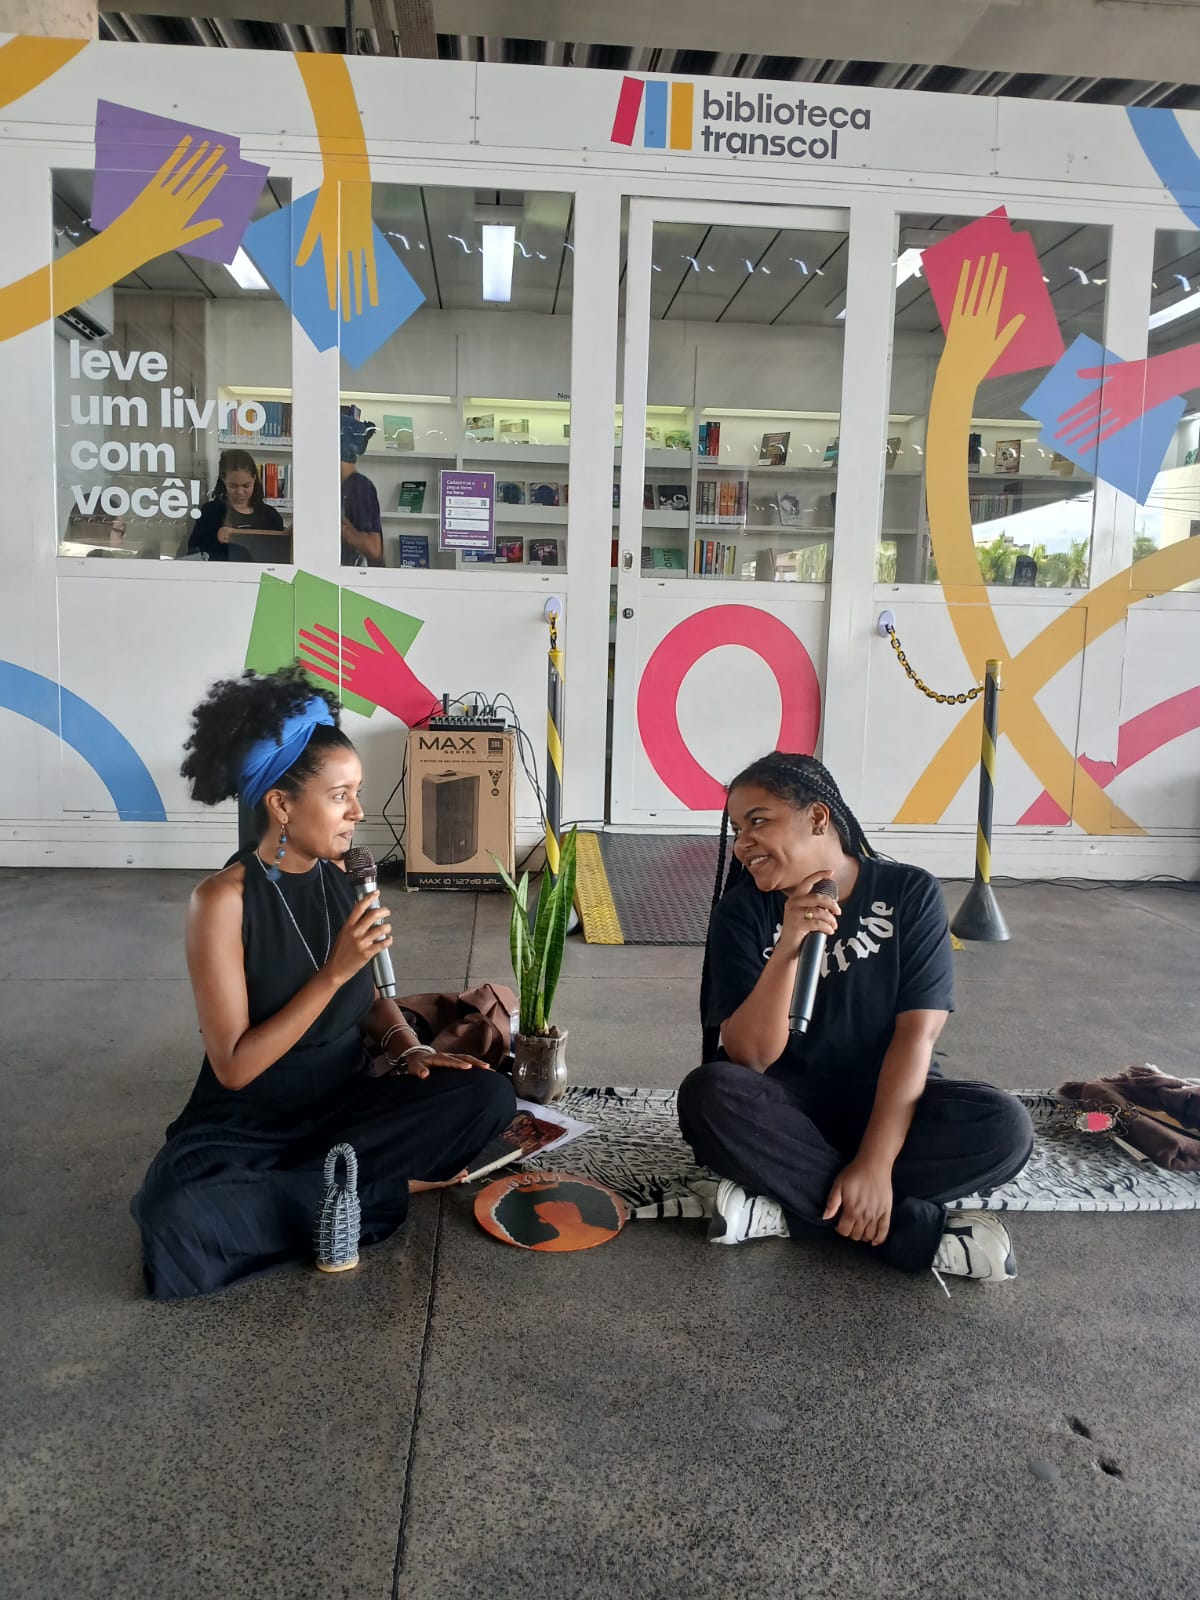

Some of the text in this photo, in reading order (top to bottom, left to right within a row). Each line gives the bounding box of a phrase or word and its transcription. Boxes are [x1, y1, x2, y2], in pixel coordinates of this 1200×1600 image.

[703, 89, 871, 130] biblioteca
[701, 125, 838, 160] transcol
[70, 339, 168, 382] leve
[70, 386, 267, 432] um livro
[70, 440, 176, 473] com
[71, 478, 202, 520] você!
[419, 736, 476, 750] MAX
